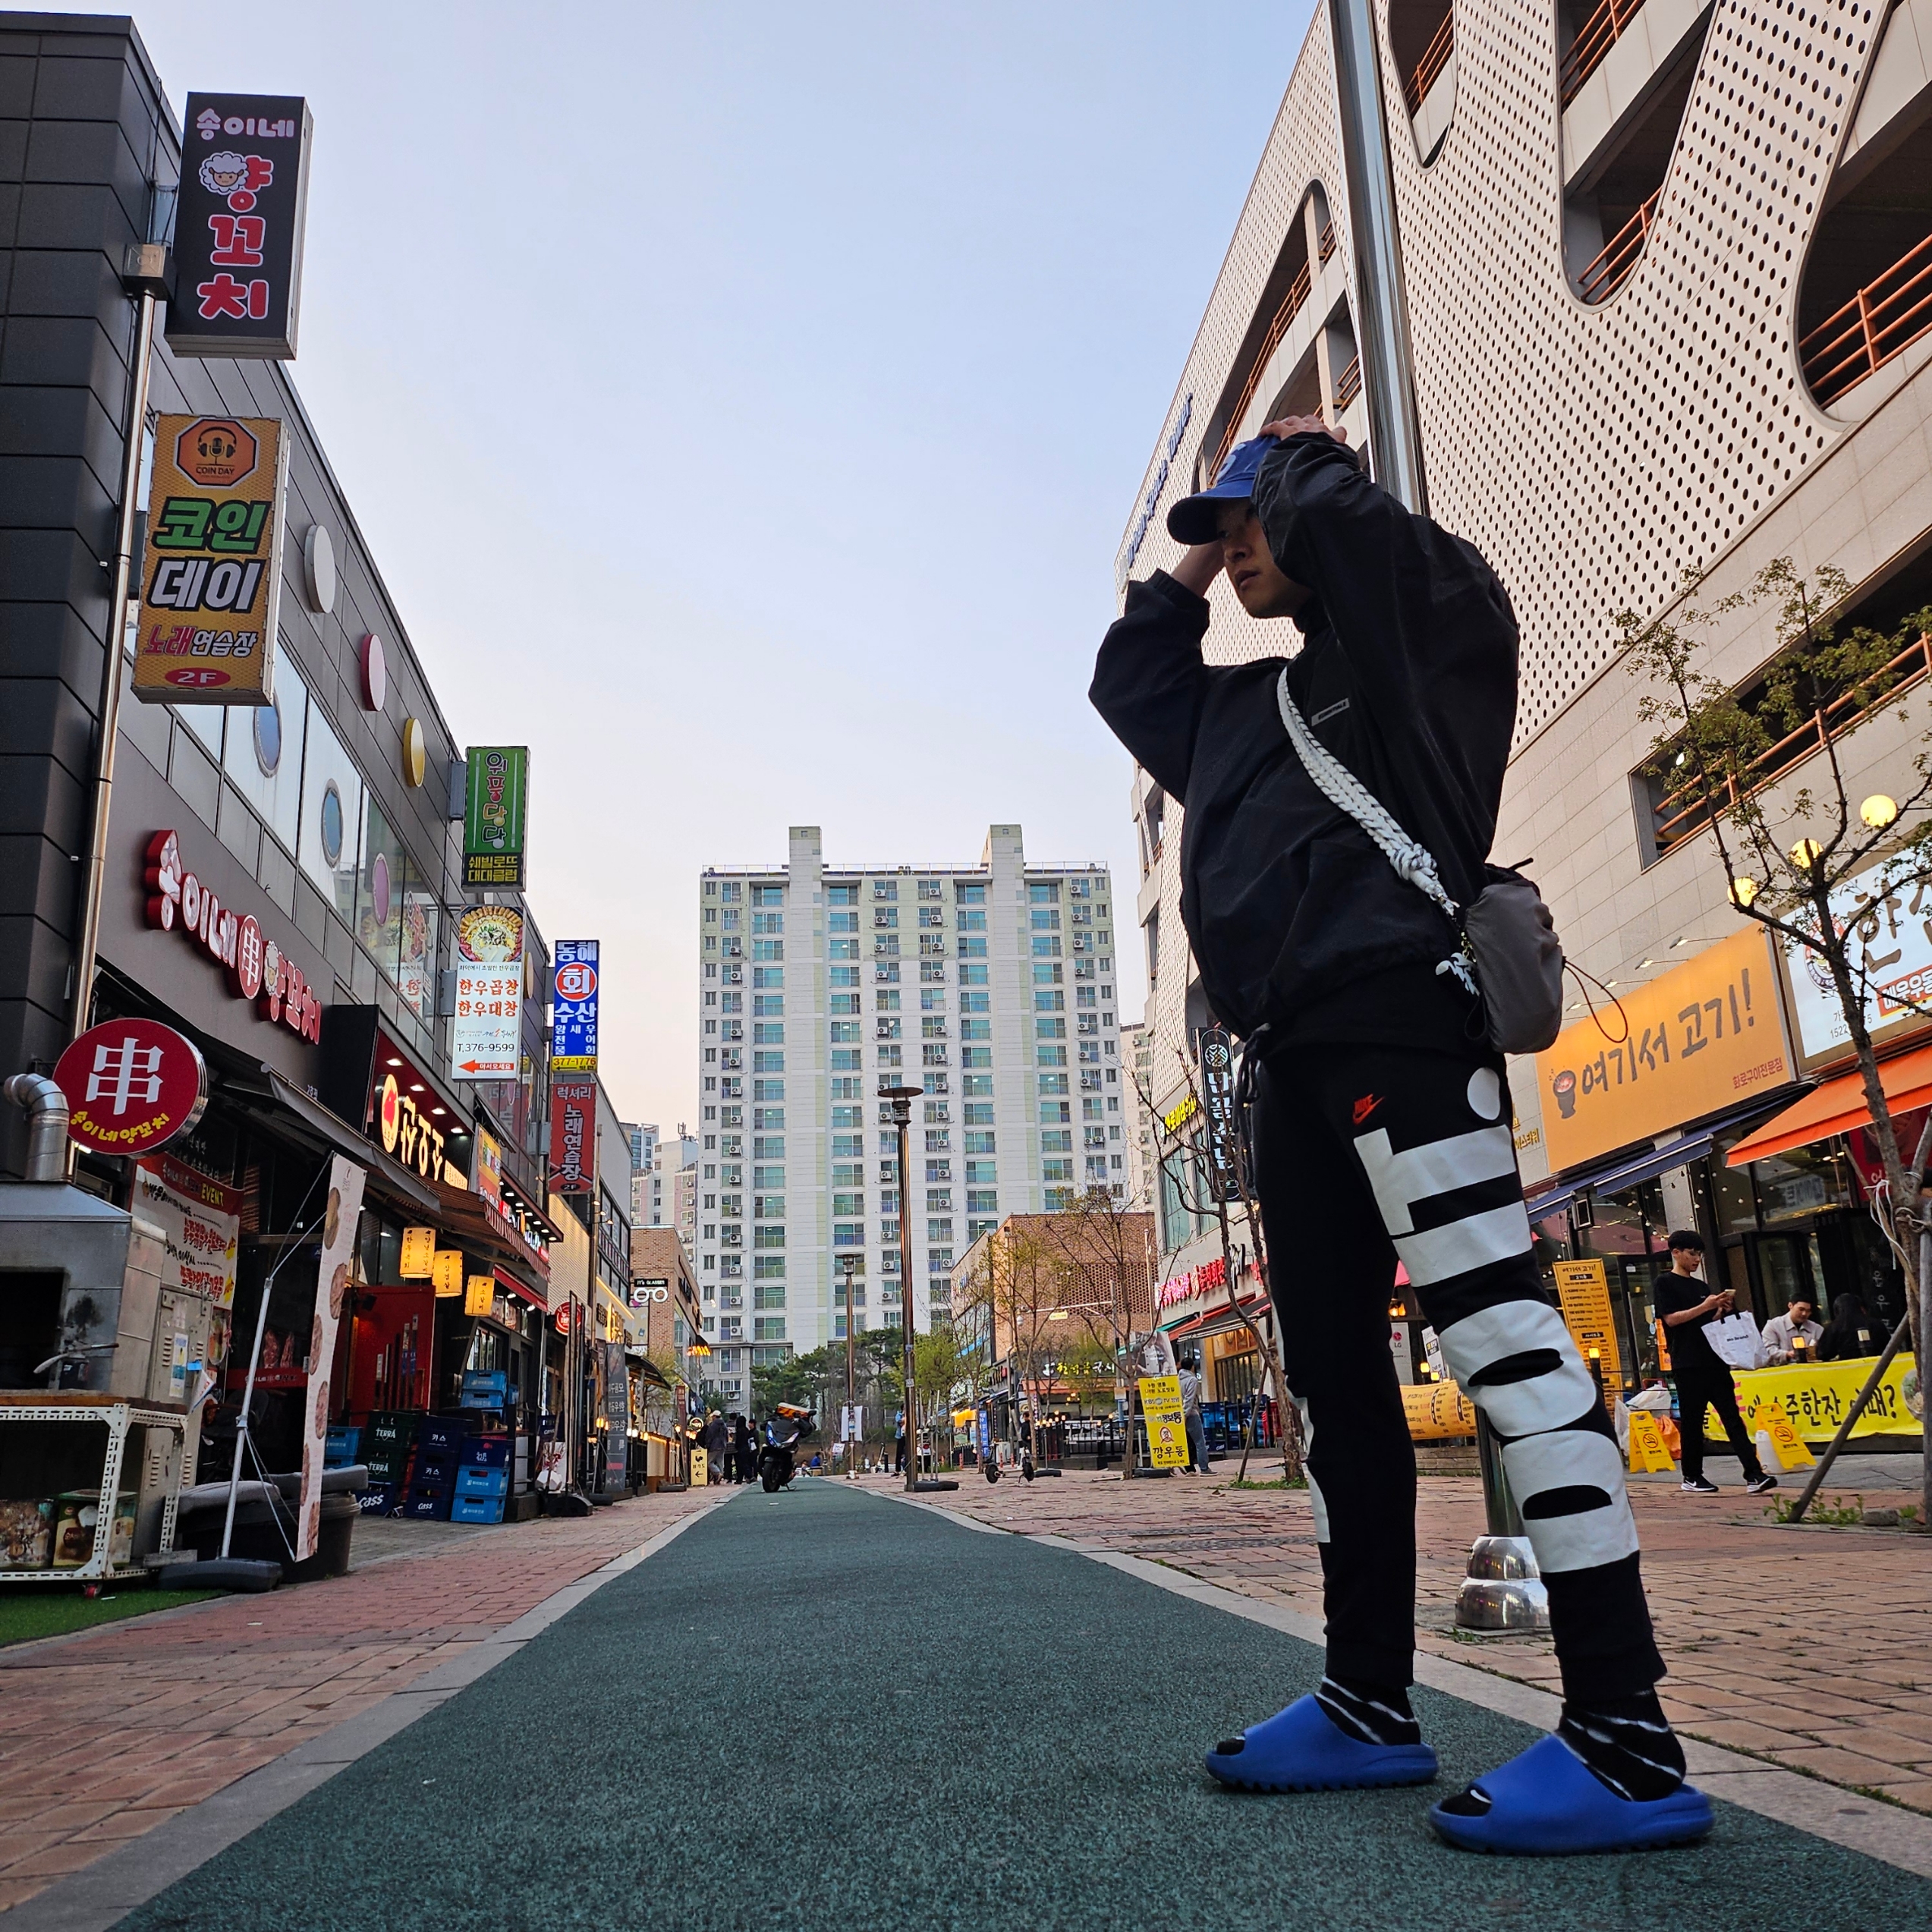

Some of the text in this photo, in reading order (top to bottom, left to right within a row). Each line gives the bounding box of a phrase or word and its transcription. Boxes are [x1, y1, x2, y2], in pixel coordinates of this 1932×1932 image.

[197, 108, 294, 140] 송이네
[197, 152, 274, 319] 양꼬치
[218, 467, 234, 476] DAY
[154, 498, 269, 552] 코인
[149, 559, 263, 612] 데이
[143, 625, 258, 657] 노래연습장
[177, 671, 217, 684] 2F
[467, 869, 518, 882] 대대클럽
[153, 829, 238, 968] 송이네
[556, 942, 597, 962] 동해
[458, 978, 519, 996] 한우곱창
[562, 968, 590, 994] 회
[458, 1000, 518, 1018] 한우대창
[554, 1002, 597, 1024] 수산
[1582, 968, 1756, 1095] 여기서 고기!
[457, 1043, 514, 1053] T.376-9599
[553, 1057, 596, 1066] 377-1776
[86, 1037, 165, 1115] 串
[1732, 1057, 1783, 1090] 화로구이전문점
[556, 1087, 592, 1100] 럭셔리
[70, 1109, 170, 1144] 송이네양꼬치
[561, 1103, 584, 1181] 노래연습장
[201, 1182, 224, 1207] EVENT
[376, 1427, 396, 1439] TERRA
[432, 1433, 446, 1442] 카스
[1153, 1446, 1185, 1459] 깡우동
[368, 1462, 389, 1473] TERRA
[425, 1467, 440, 1475] 카스
